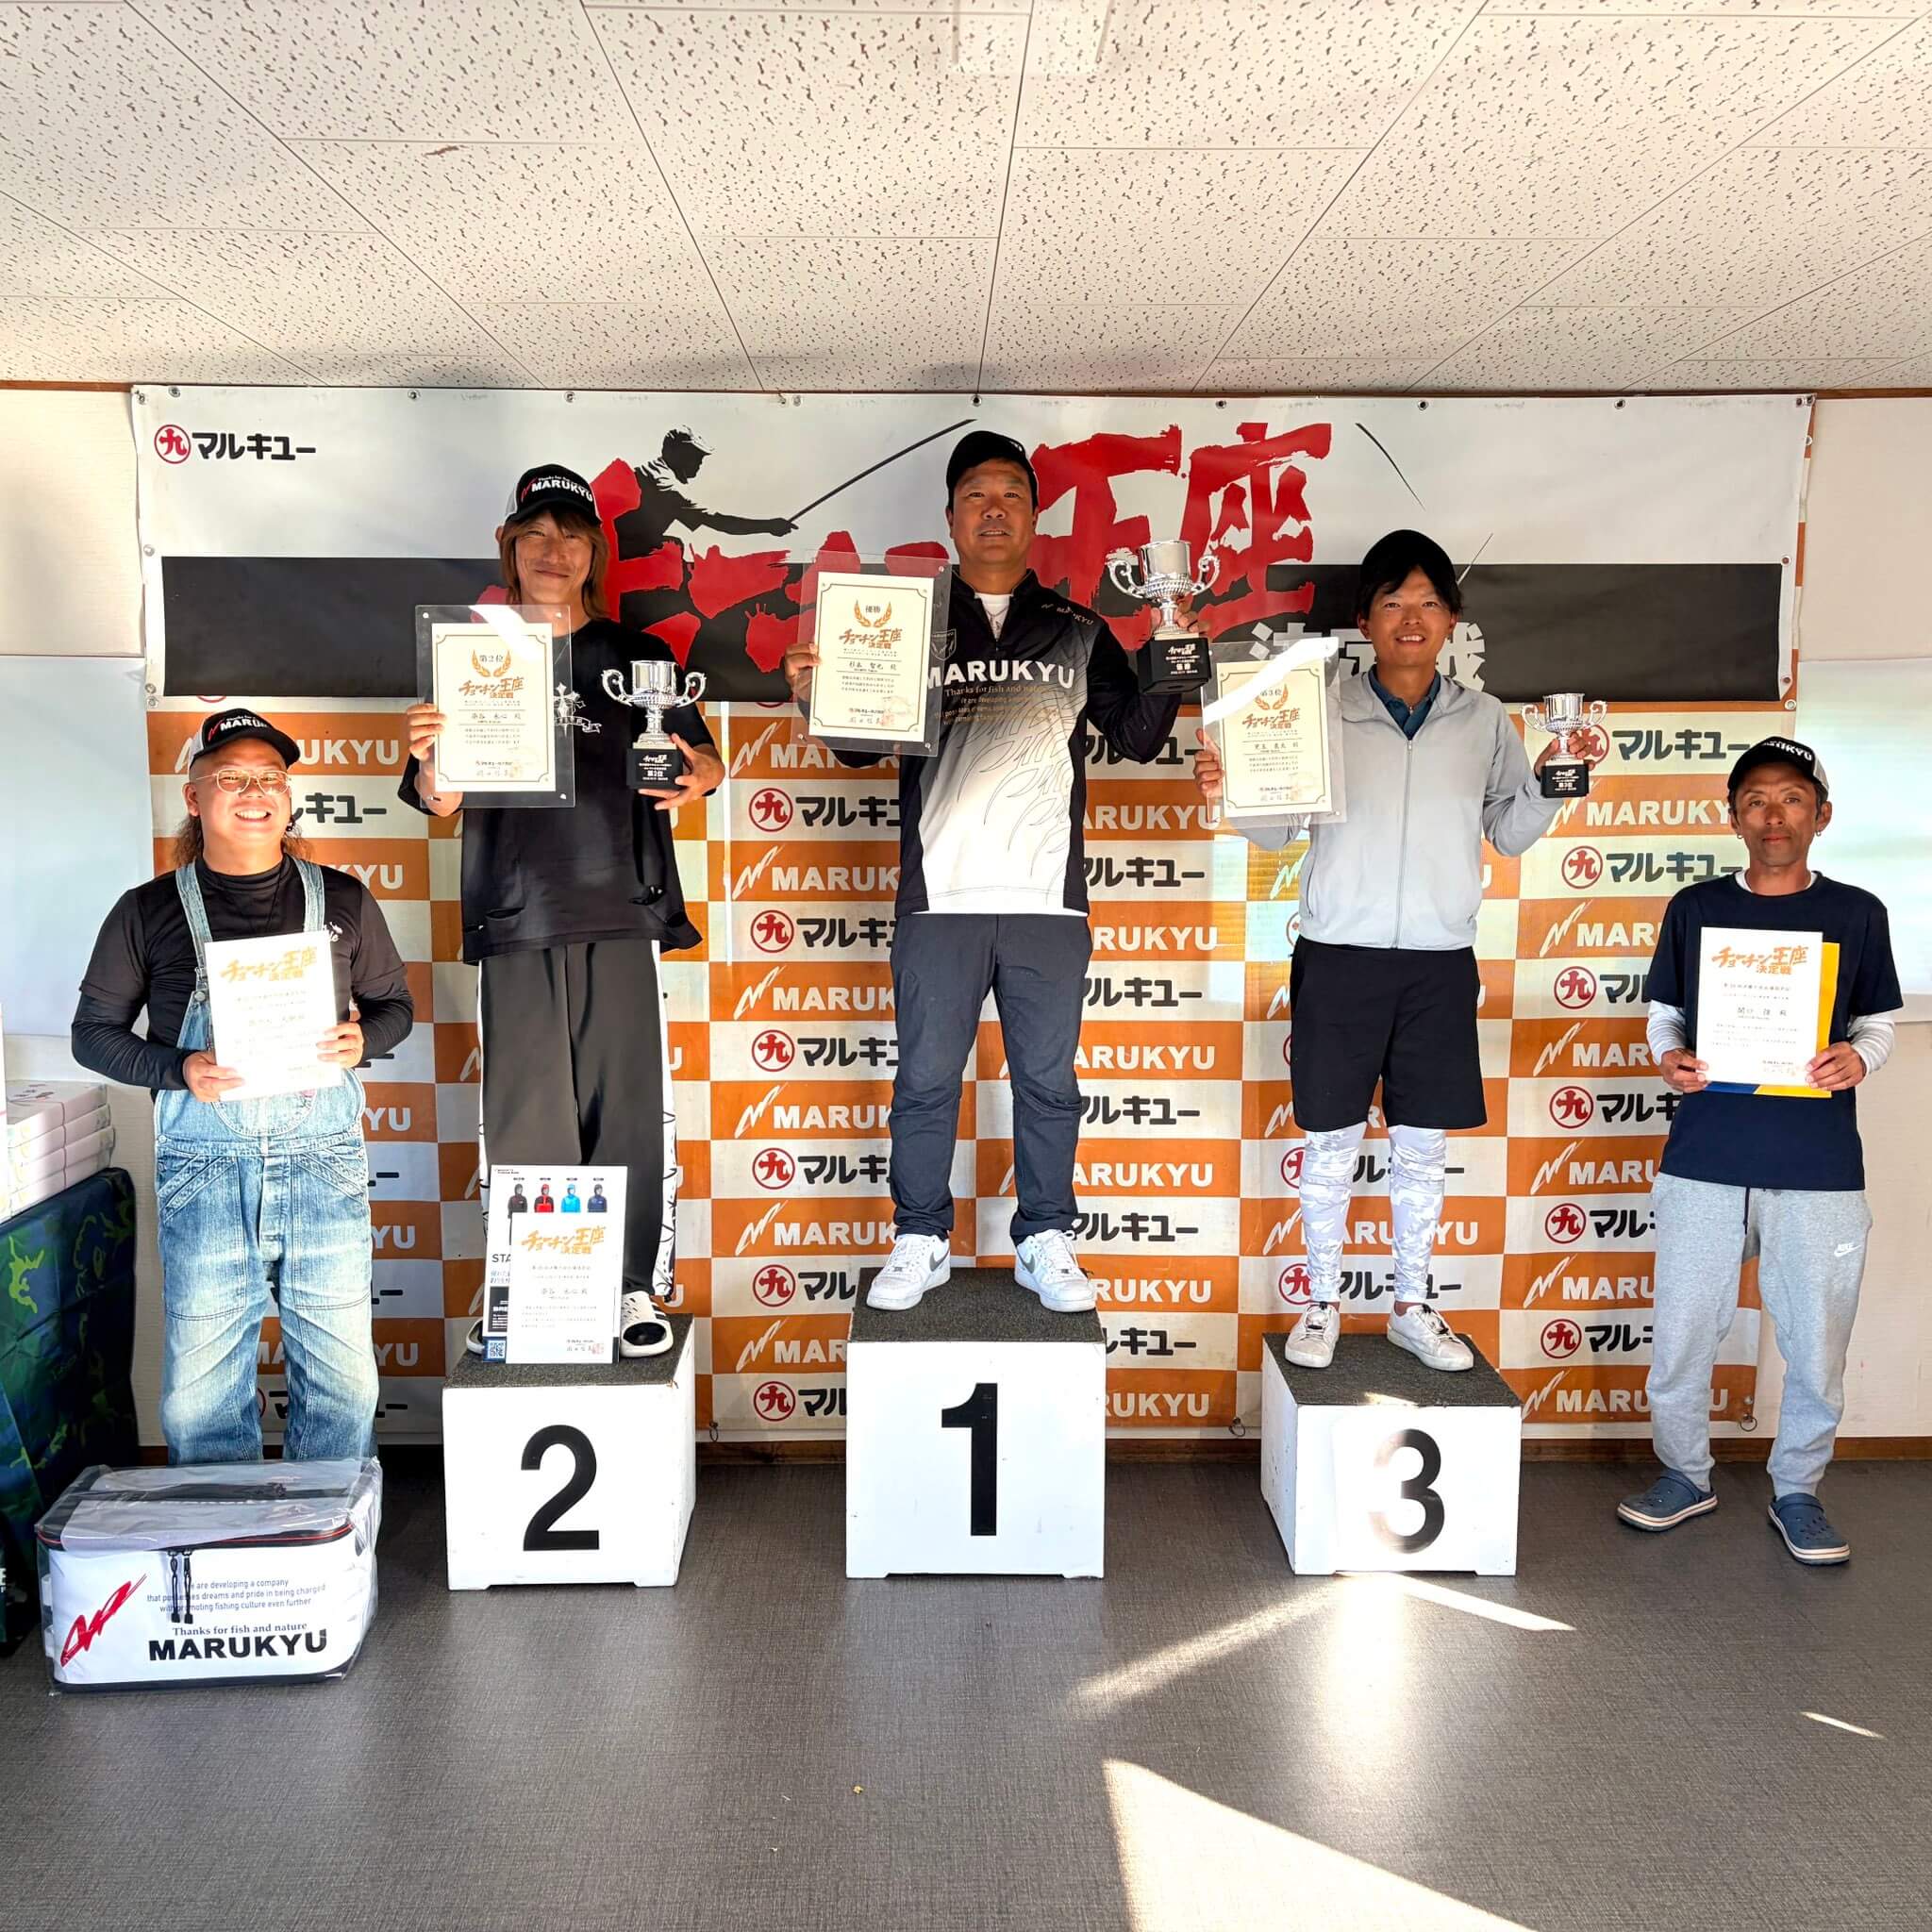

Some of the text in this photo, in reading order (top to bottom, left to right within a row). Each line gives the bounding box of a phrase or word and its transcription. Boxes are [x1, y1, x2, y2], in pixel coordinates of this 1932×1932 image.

[531, 479, 593, 503] MARUKYU
[927, 659, 1074, 690] MARUKYU
[220, 718, 267, 732] MARU
[299, 740, 400, 765] UKYU
[1586, 799, 1731, 826] MARUKY
[772, 866, 901, 891] MARUK
[1092, 926, 1218, 951] RUKYU
[773, 986, 896, 1011] MARUK
[1074, 1045, 1216, 1070] ARUKYU
[1073, 1162, 1214, 1188] ARUKYU
[1568, 1159, 1659, 1186] MARU
[774, 1222, 896, 1246] MARUK
[1093, 1279, 1212, 1304] RUKYU
[1562, 1275, 1655, 1301] MARU
[1106, 1393, 1210, 1417] UKYU
[941, 1382, 997, 1536] 1
[521, 1425, 600, 1551] 2
[1374, 1428, 1443, 1554] 3
[202, 1591, 229, 1600] dreams
[231, 1591, 244, 1599] and
[246, 1590, 265, 1600] pride
[266, 1589, 274, 1597] in
[210, 1580, 249, 1591] developing
[257, 1579, 289, 1588] company
[241, 1600, 266, 1609] culture
[286, 1597, 311, 1607] further
[173, 1622, 308, 1637] Thanks for fish and nature
[148, 1628, 327, 1661] MARUKYU
